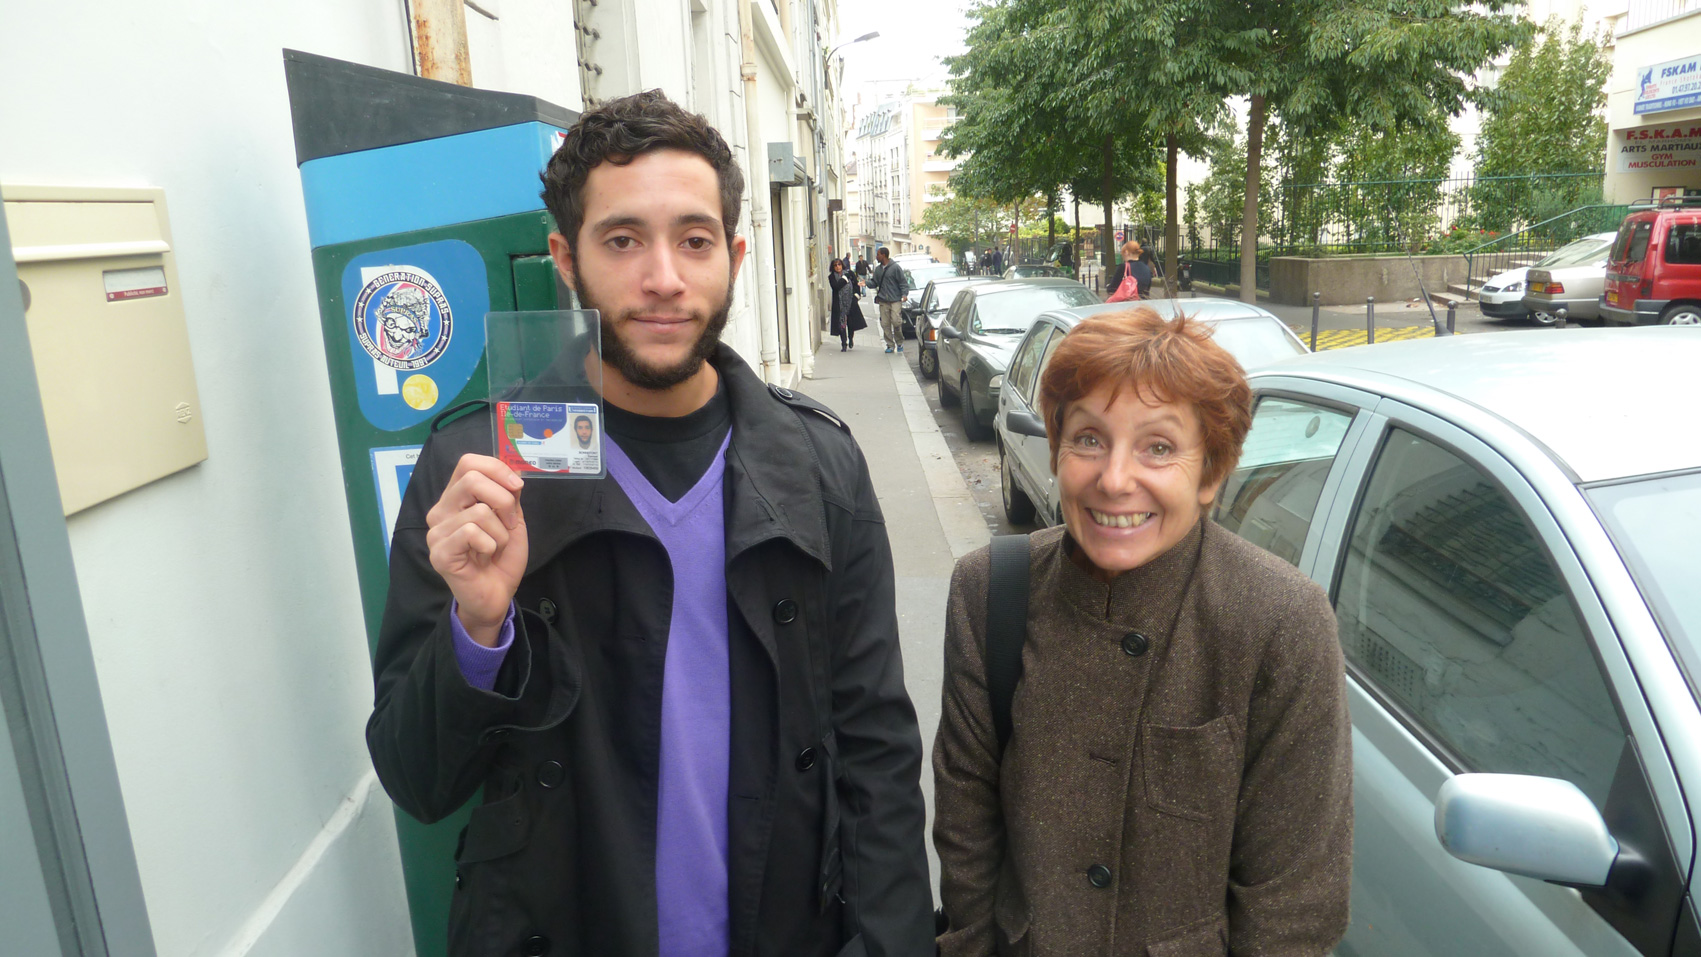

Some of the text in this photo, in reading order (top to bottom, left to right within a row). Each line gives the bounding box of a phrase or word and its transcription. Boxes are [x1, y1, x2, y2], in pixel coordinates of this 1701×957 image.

[1661, 62, 1697, 78] FSKAM
[1621, 145, 1647, 153] ARTS
[1628, 159, 1696, 168] MUSCULATION
[372, 271, 450, 315] GENERATION SUPRAS
[359, 333, 381, 359] SUPRAS
[380, 355, 410, 369] AUTEUIL
